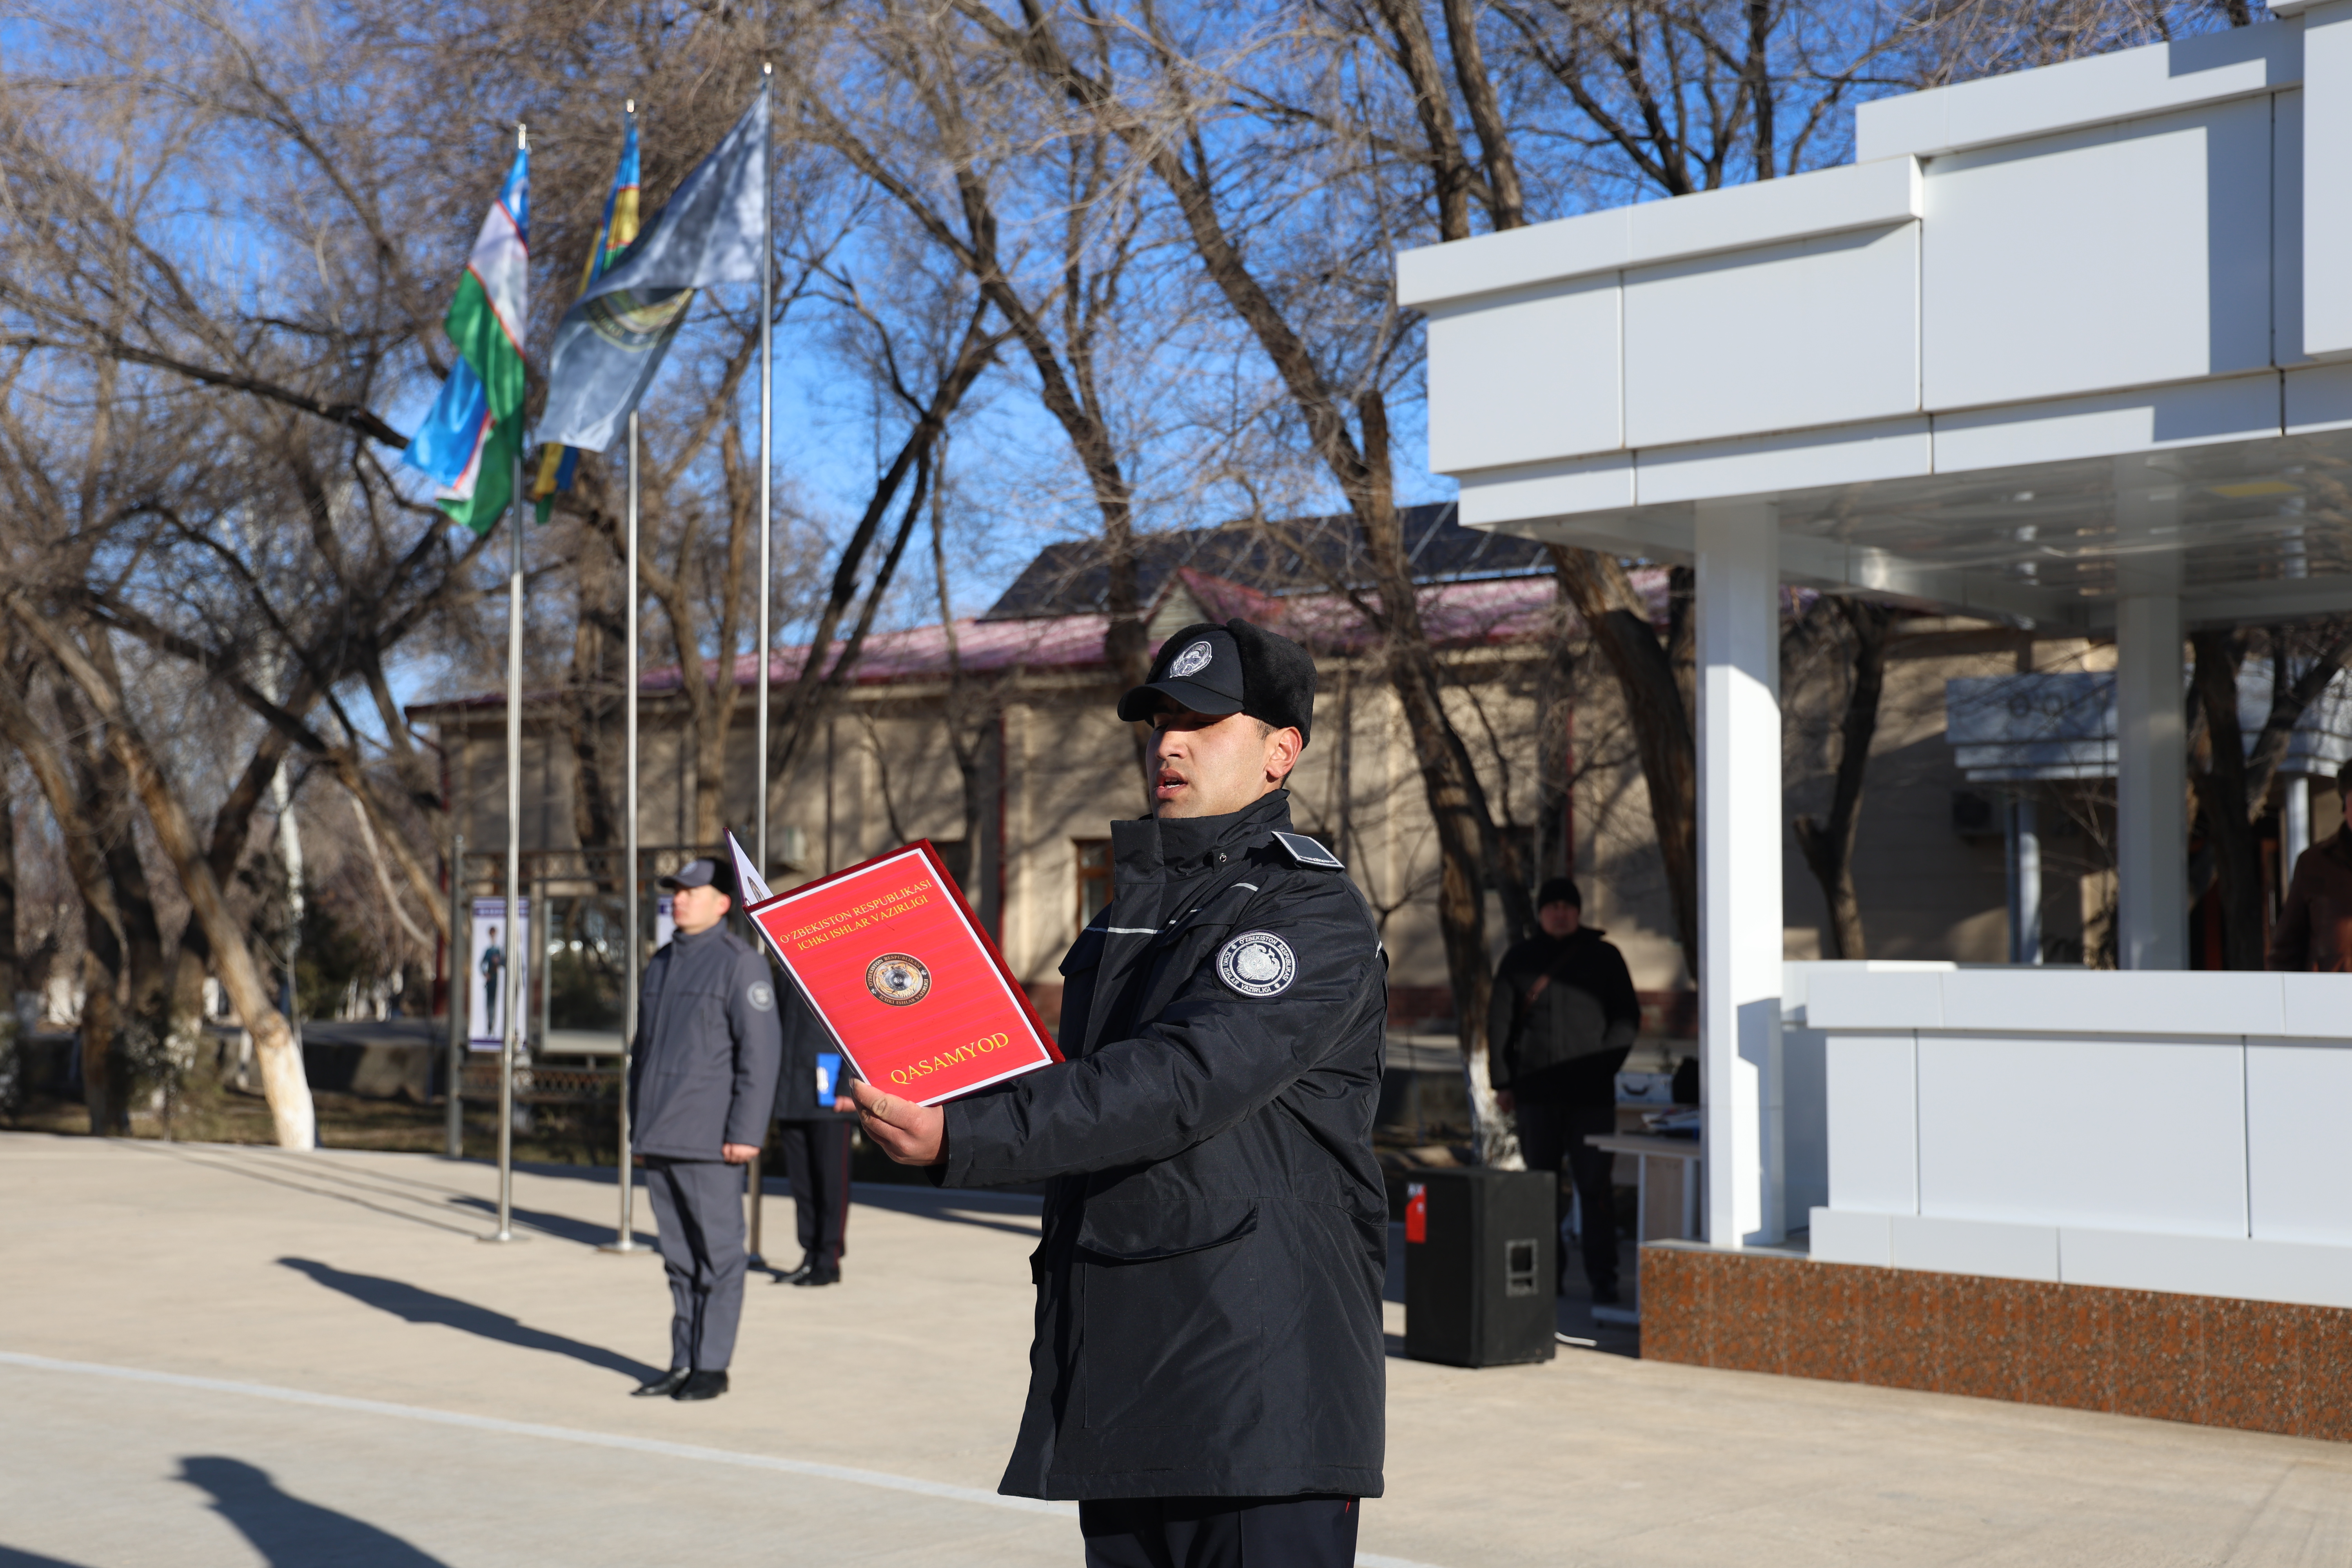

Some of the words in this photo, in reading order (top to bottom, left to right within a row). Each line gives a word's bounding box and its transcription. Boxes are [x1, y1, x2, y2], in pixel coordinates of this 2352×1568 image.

[852, 879, 933, 916] RESPUBLIKASI
[797, 933, 830, 951] ICHKI
[829, 918, 871, 938] ISHLAR
[870, 895, 929, 922] VAZIRLIGI
[884, 955, 922, 968] RESPUBLIKASI
[1221, 951, 1232, 966] ICHKI
[1278, 944, 1292, 981] RESPUBLIKASI
[1223, 968, 1239, 985] ISHLAR
[1241, 984, 1272, 993] VAZIRLIGI
[879, 995, 895, 1004] ICHKI
[915, 978, 929, 1000] VAZIRLIGI
[891, 1033, 1009, 1085] QASAMYOD
